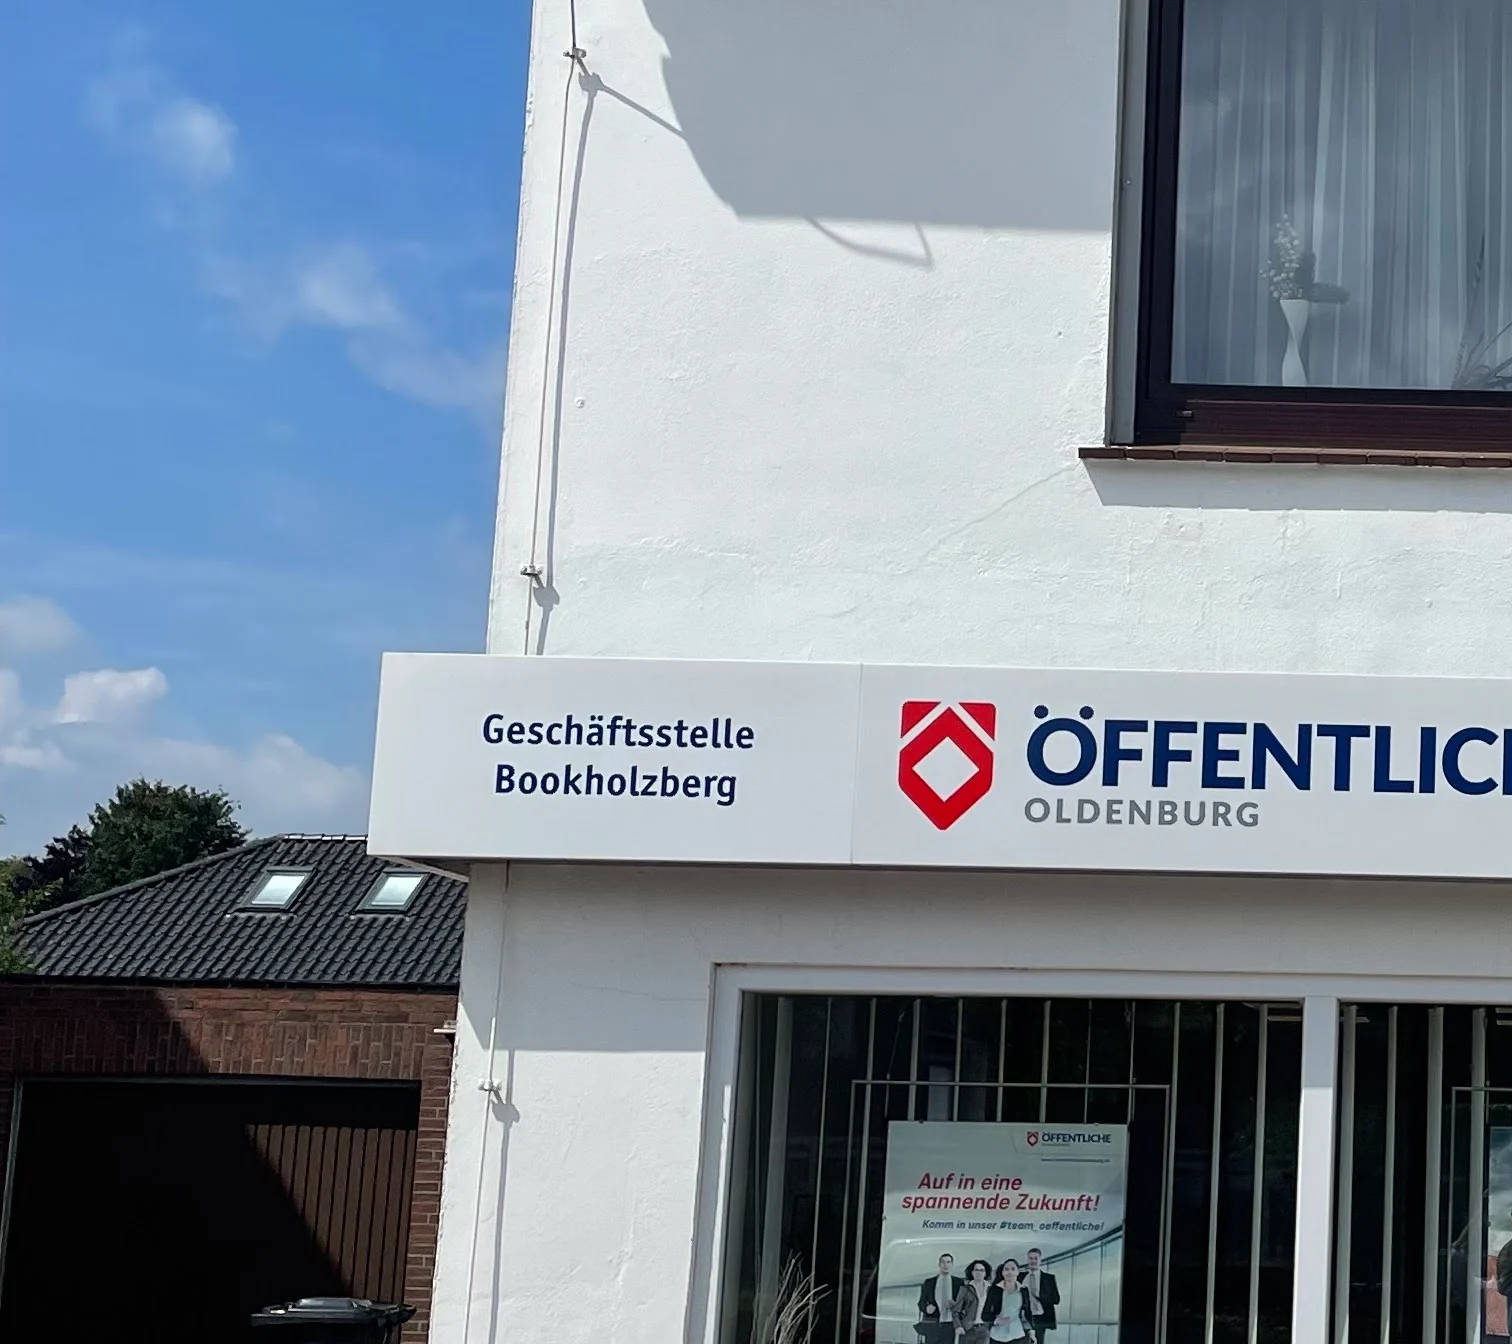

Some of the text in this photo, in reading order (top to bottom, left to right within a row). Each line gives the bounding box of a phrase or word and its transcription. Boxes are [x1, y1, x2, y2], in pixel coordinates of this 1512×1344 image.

[483, 714, 756, 751] Geschäftsstelle
[495, 764, 738, 808] Bookholzberg
[1025, 798, 1260, 829] OLDENBURG
[1041, 1131, 1111, 1144] ÖFFENTLICHE
[917, 1172, 1023, 1191] Auf in eine
[902, 1194, 1100, 1213] spannende Zukunft!
[922, 1219, 953, 1230] Komm
[956, 1219, 966, 1230] in
[968, 1221, 997, 1231] unser
